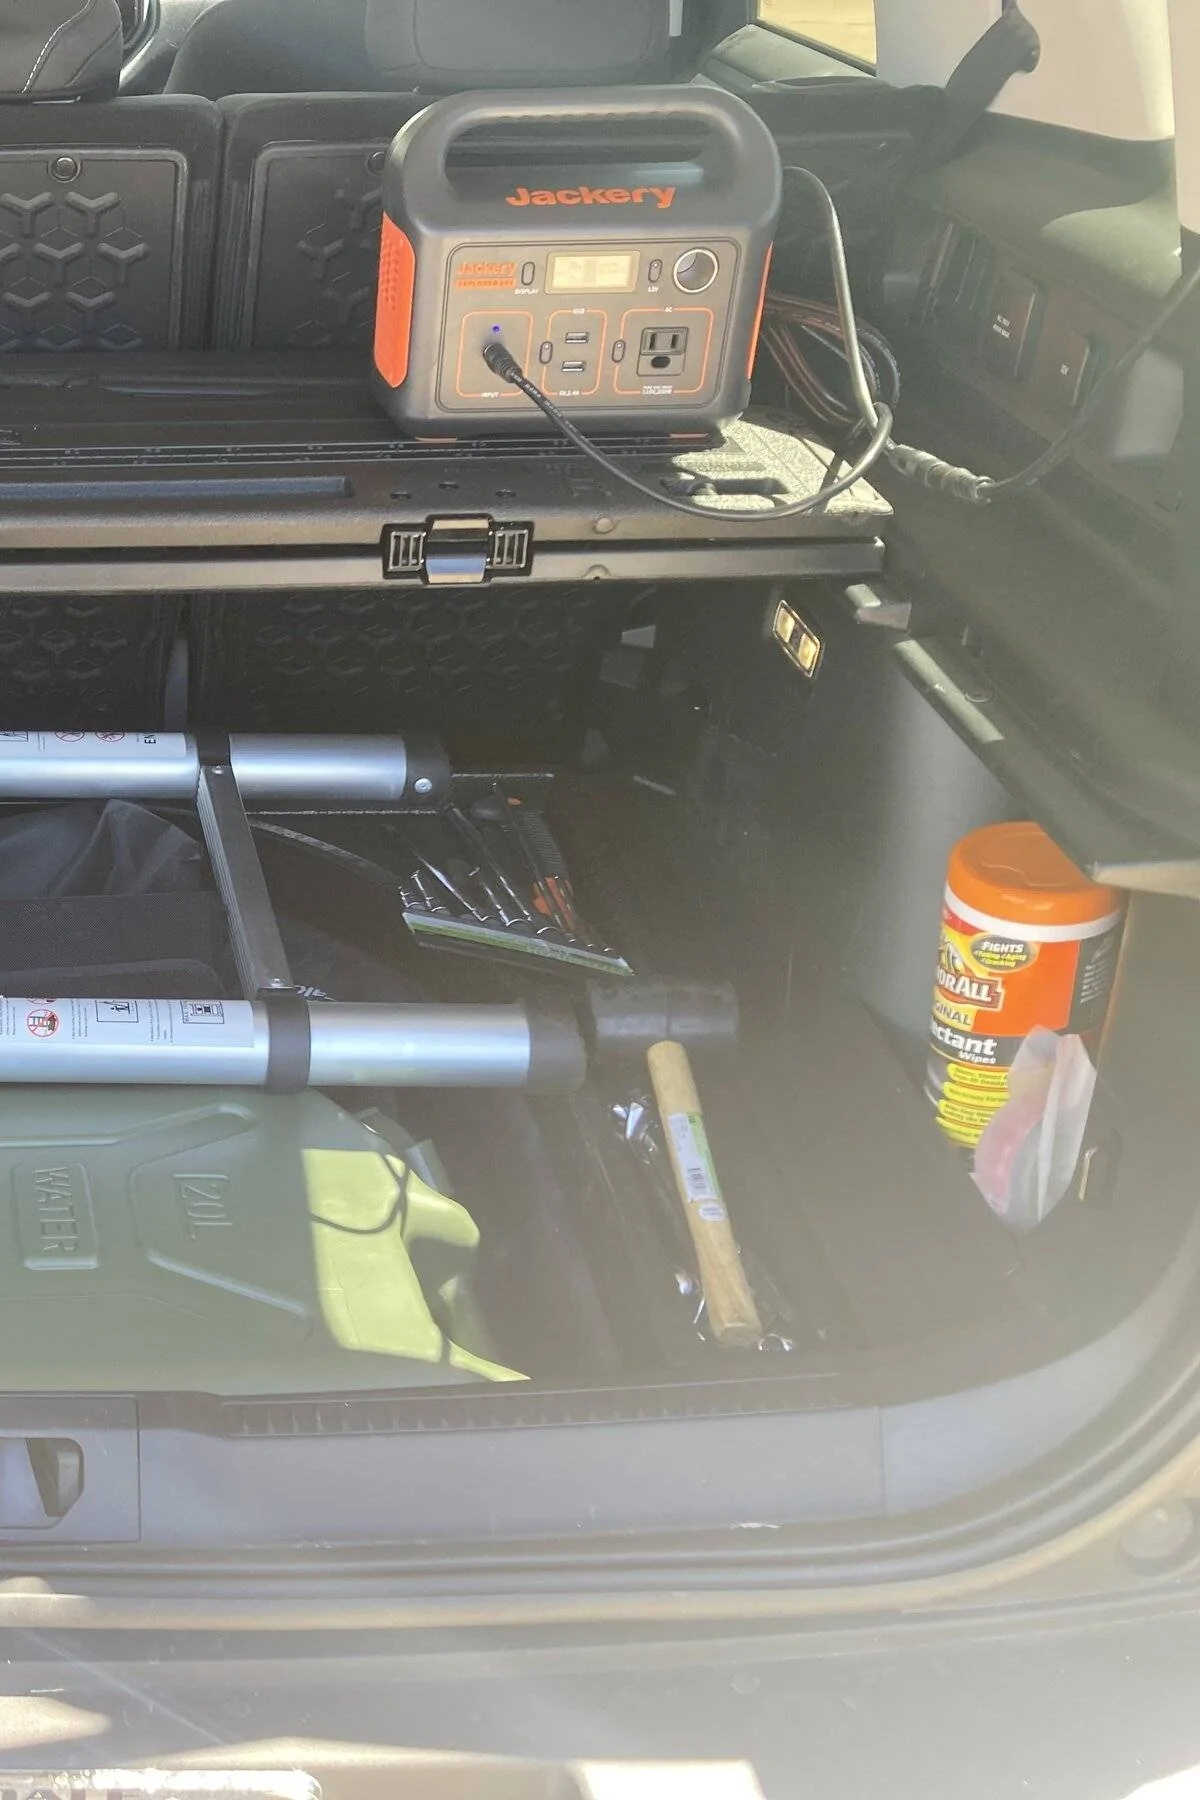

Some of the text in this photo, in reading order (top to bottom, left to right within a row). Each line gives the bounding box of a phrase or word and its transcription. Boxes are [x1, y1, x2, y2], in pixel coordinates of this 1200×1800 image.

[505, 186, 676, 209] Jackery
[982, 941, 1024, 953] FIGHTS
[958, 1051, 996, 1064] Wipes
[32, 1167, 80, 1252] WATER
